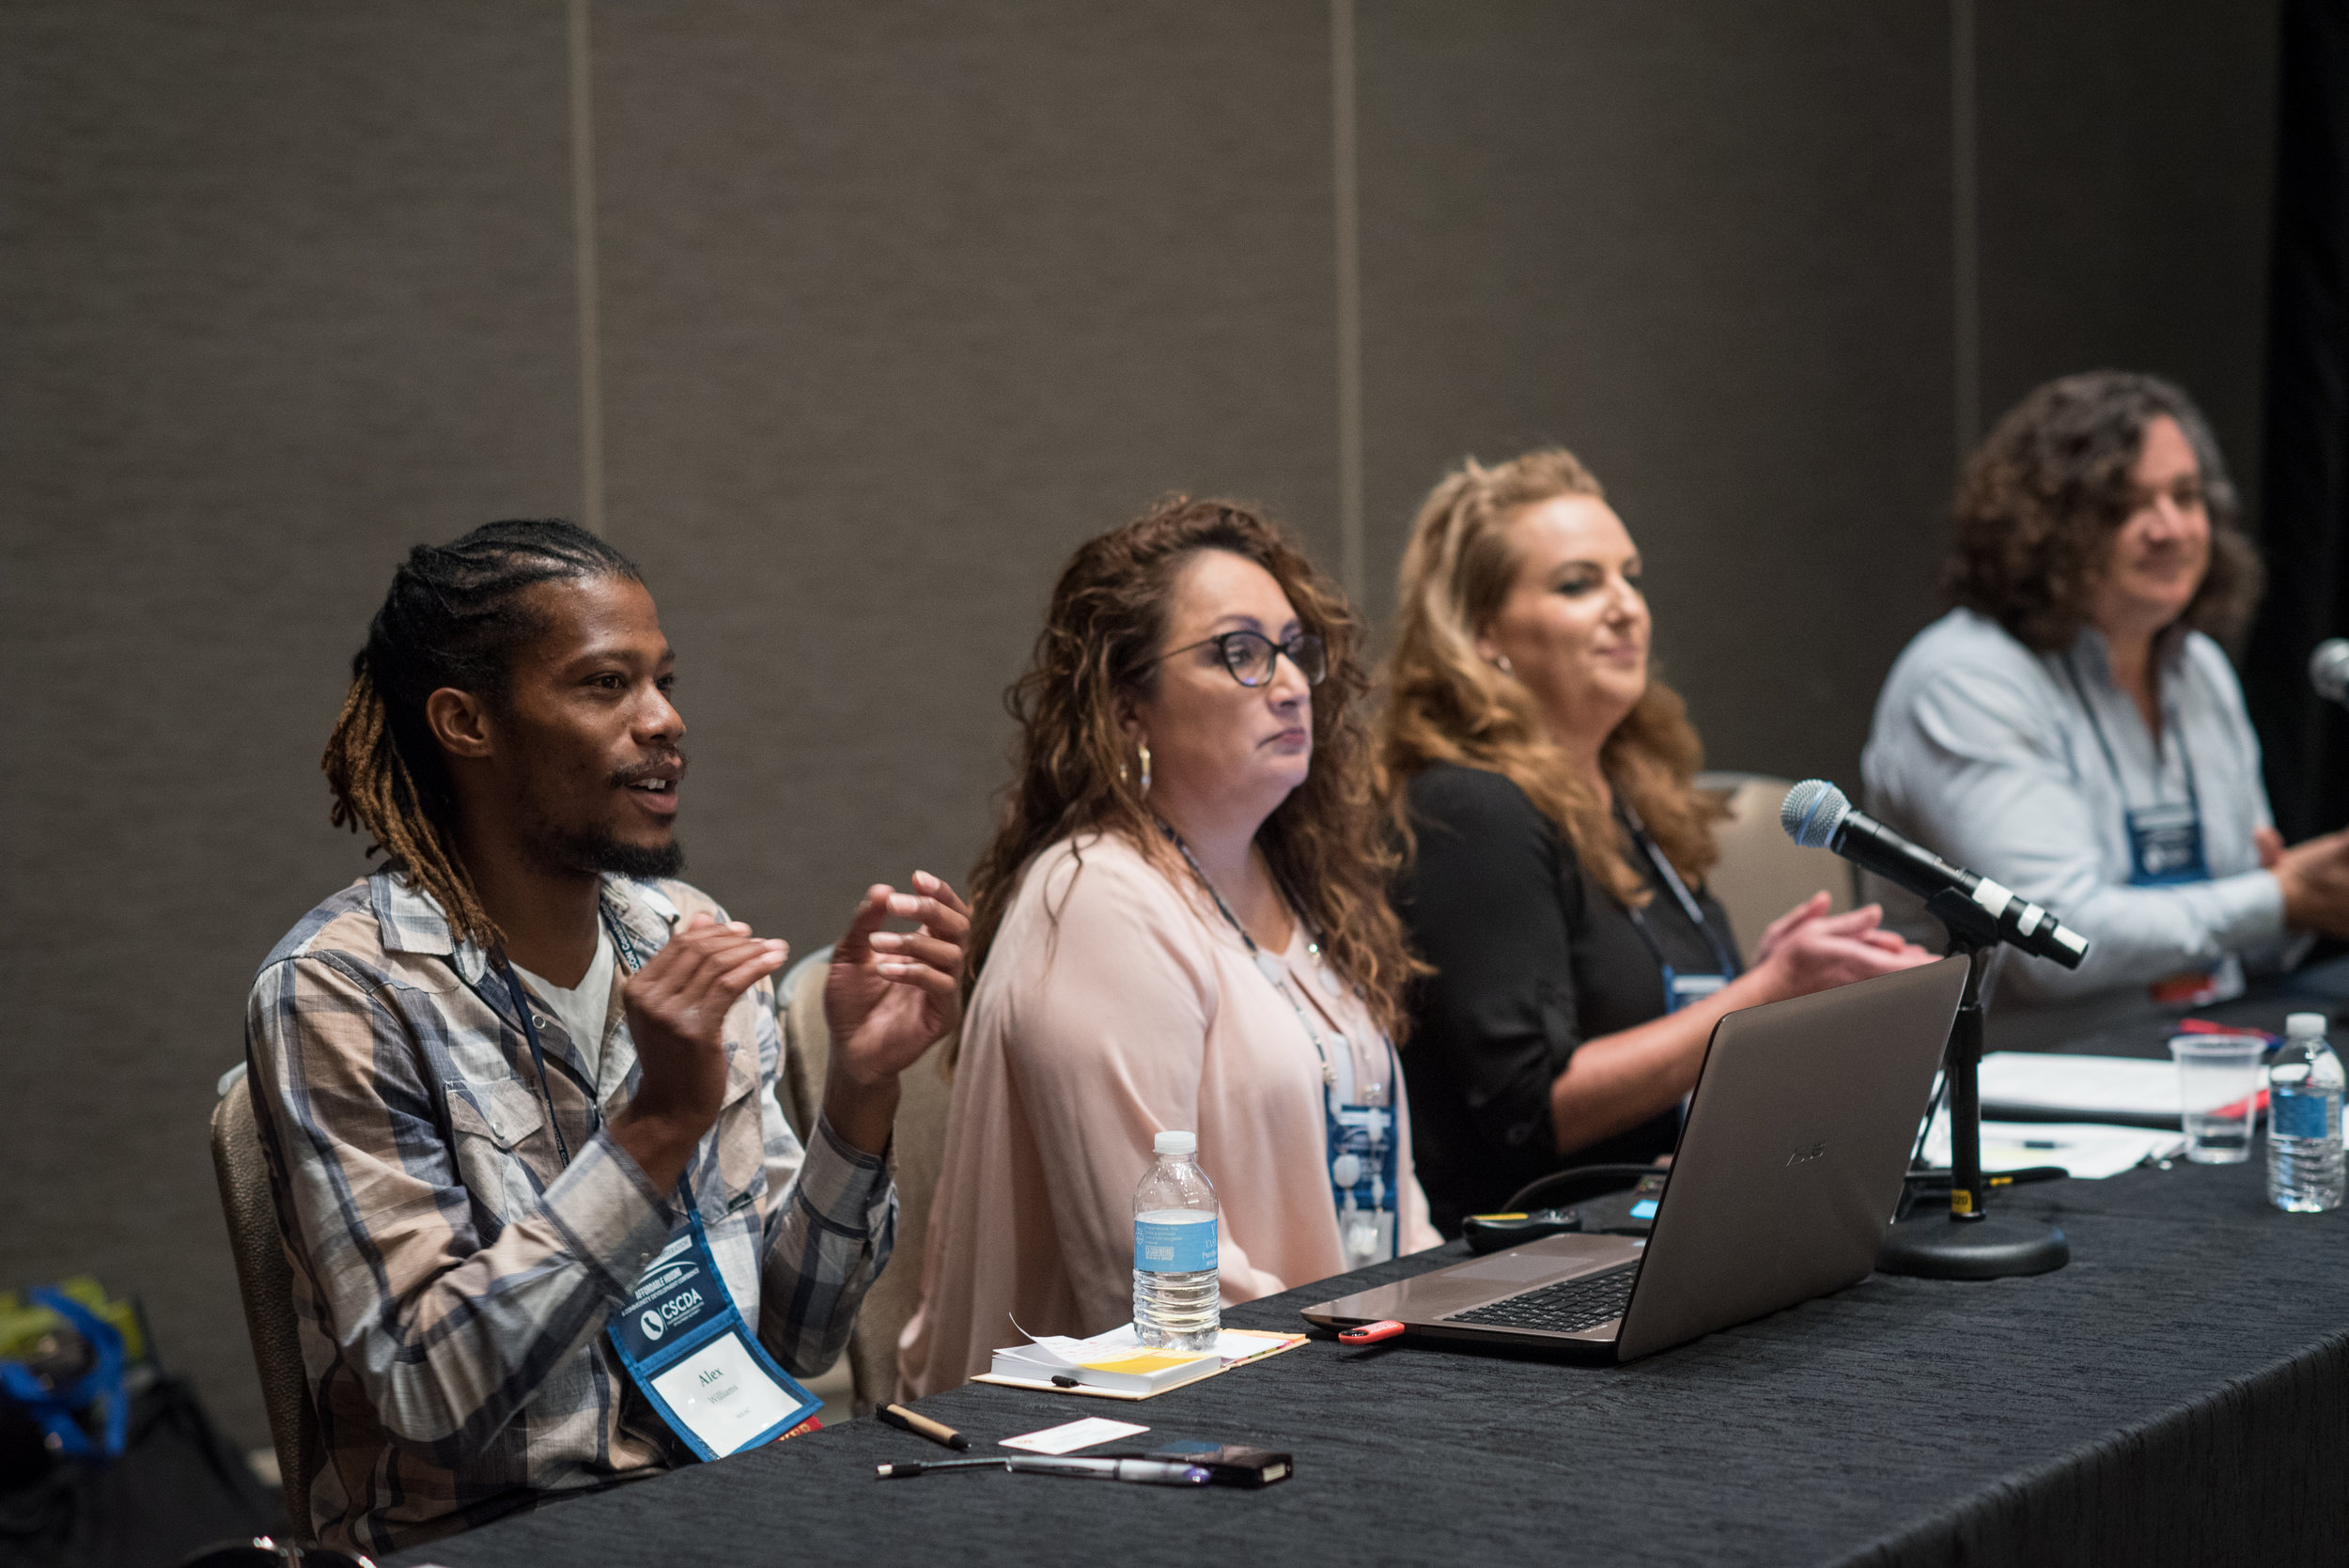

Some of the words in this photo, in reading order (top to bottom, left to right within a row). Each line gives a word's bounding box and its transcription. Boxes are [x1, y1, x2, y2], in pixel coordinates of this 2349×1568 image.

[600, 901, 630, 951] Construction
[635, 1276, 664, 1300] AFFORDABLE
[661, 1288, 703, 1319] CSCDA
[698, 1368, 723, 1388] Alex
[708, 1385, 739, 1405] Williams
